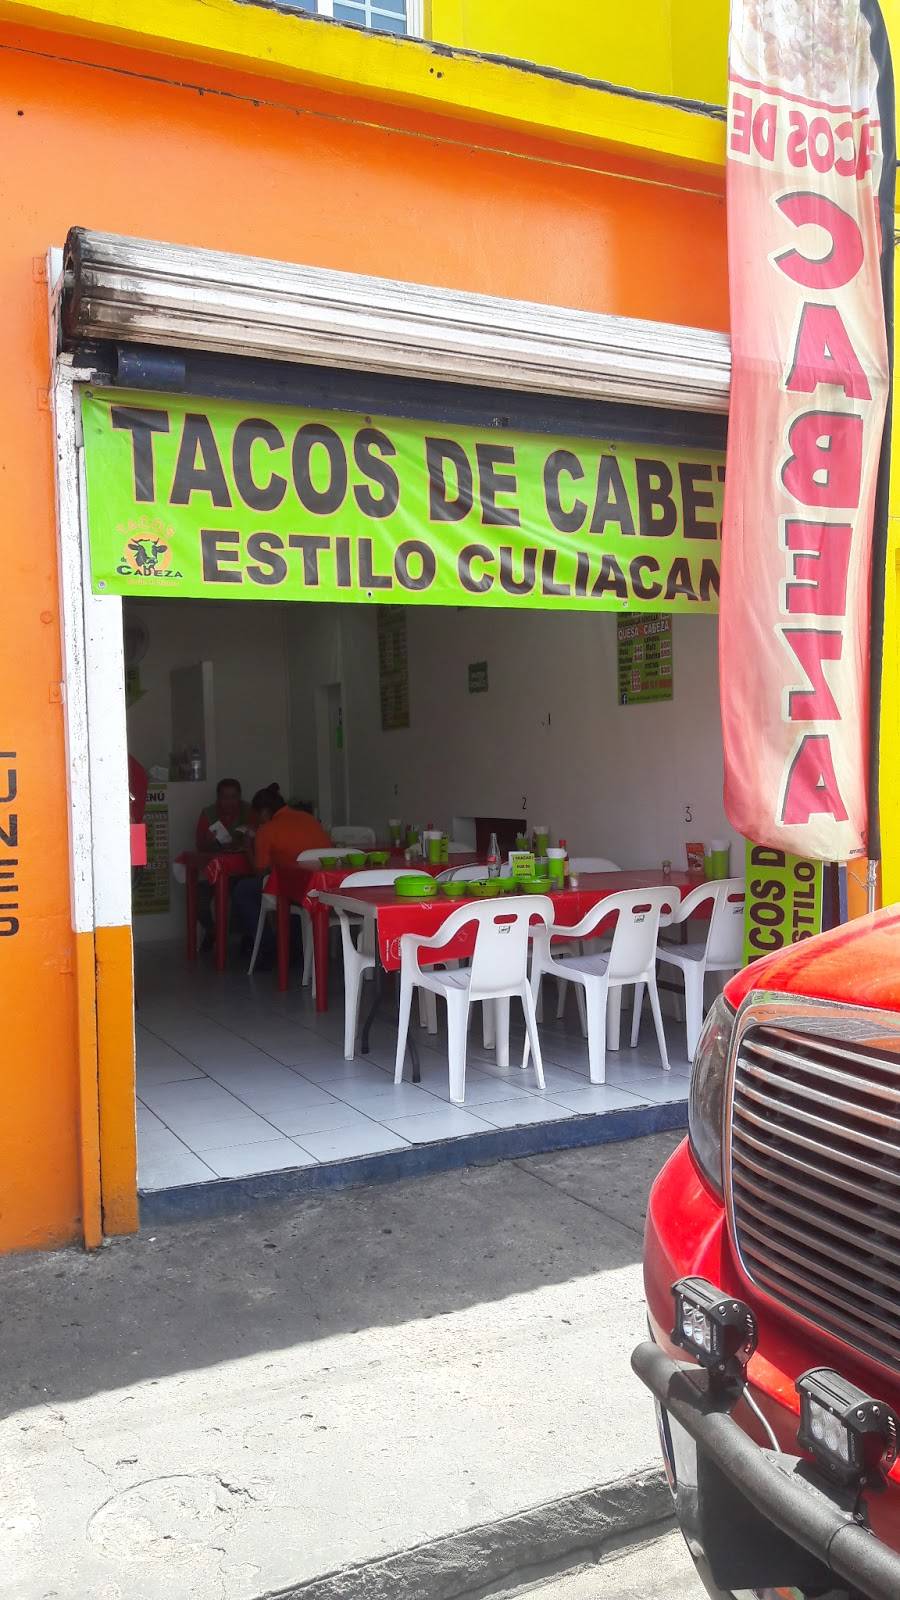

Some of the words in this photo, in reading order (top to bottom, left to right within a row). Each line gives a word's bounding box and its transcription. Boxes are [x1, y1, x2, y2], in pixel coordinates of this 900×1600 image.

[110, 404, 400, 519] TACOS
[424, 436, 521, 527] DE
[543, 449, 726, 540] CABE
[200, 529, 436, 592] ESTILO
[684, 805, 693, 823] 3
